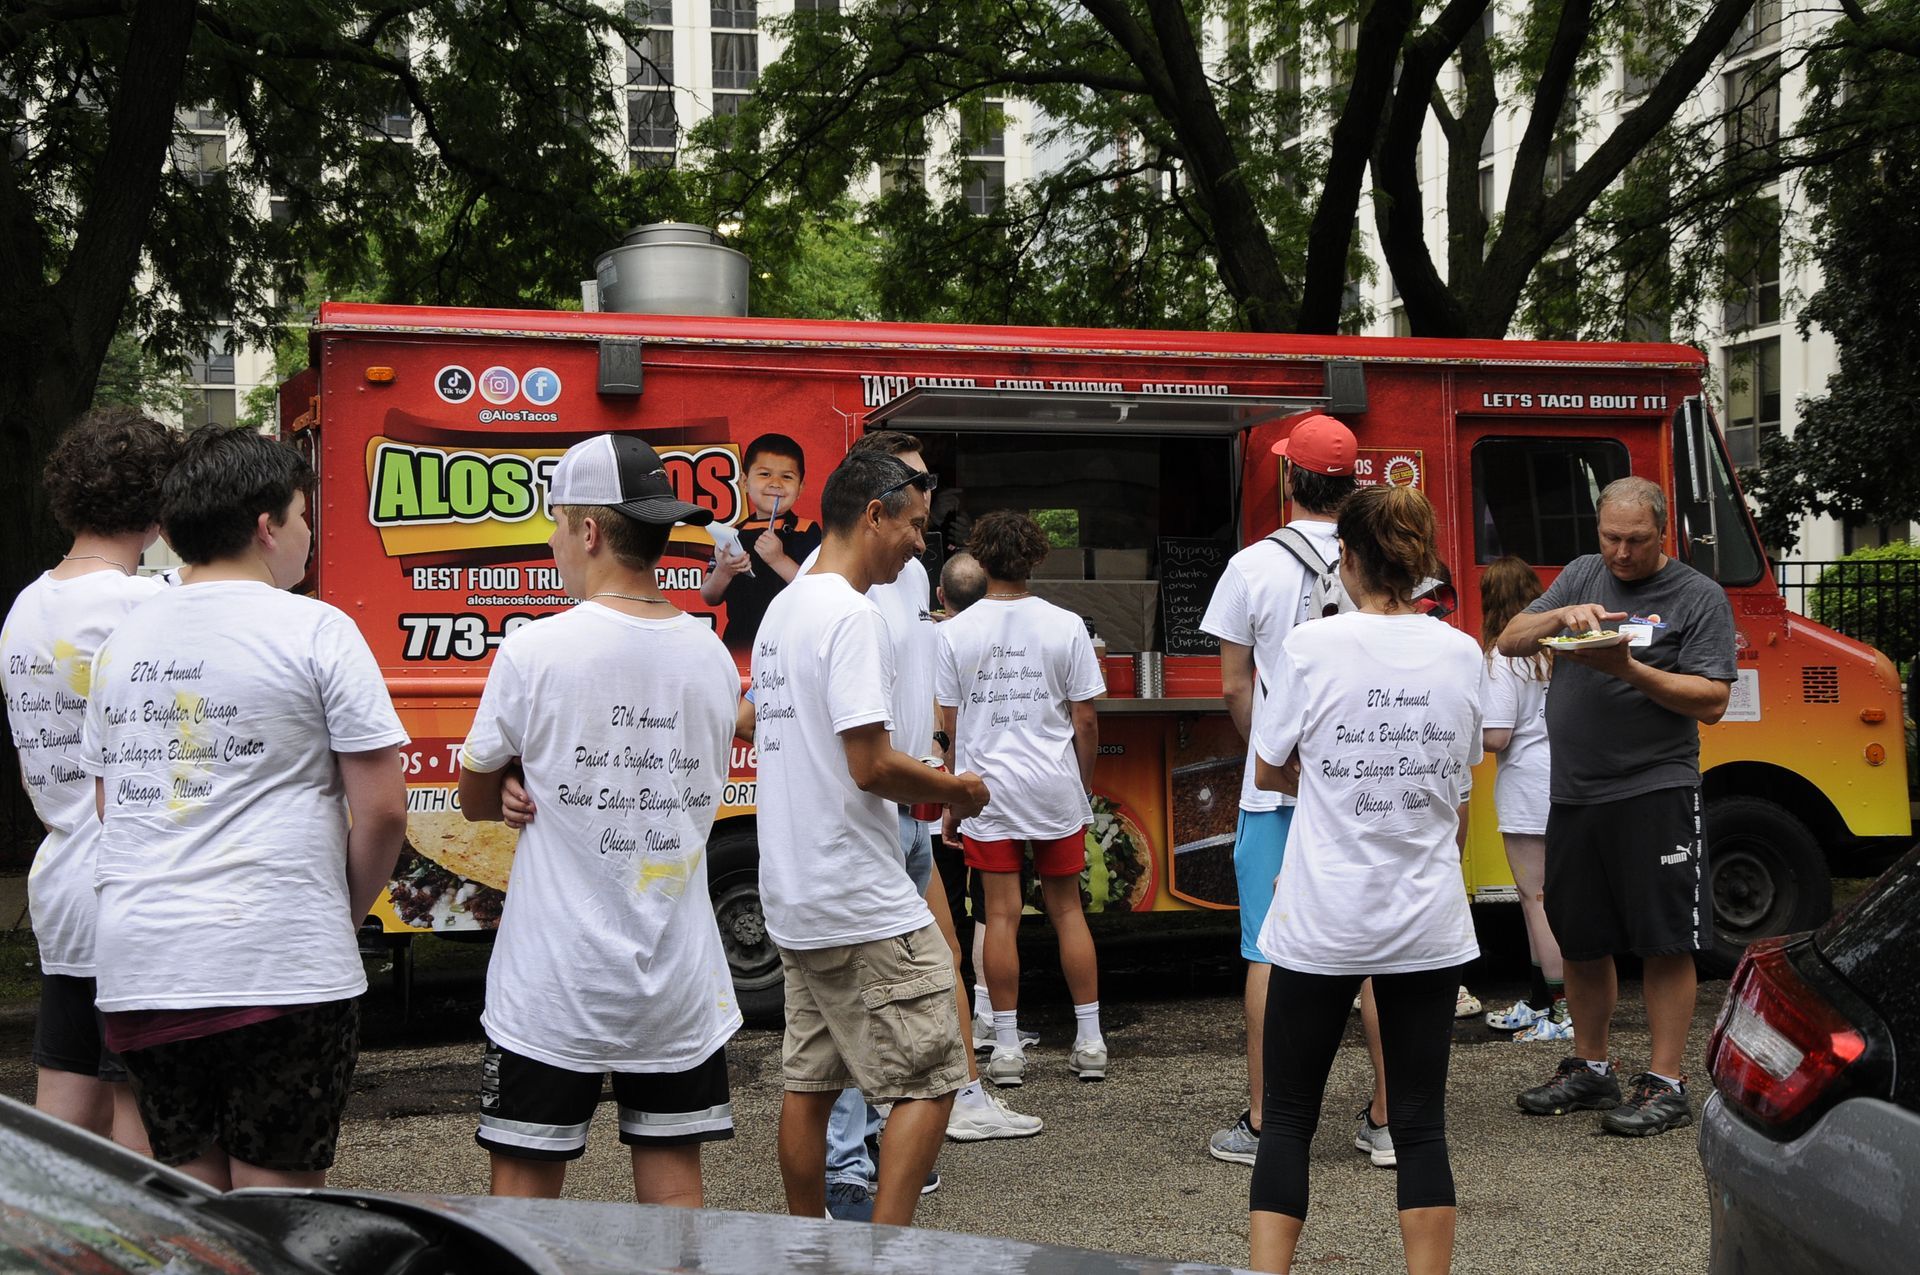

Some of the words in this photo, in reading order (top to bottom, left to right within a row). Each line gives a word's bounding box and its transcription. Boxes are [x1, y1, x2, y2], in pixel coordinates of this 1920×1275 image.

[1483, 393, 1532, 408] LET'S
[1537, 394, 1584, 408] TACO
[1590, 395, 1638, 409] BOUT
[1643, 396, 1667, 410] IT!
[479, 410, 558, 423] @AlosTacos
[375, 448, 534, 521] ALOS
[1161, 541, 1221, 560] Toppings
[413, 567, 462, 590] BEST
[468, 567, 520, 590] FOOD
[525, 567, 564, 590] TRU
[656, 566, 702, 590] CAGO
[131, 660, 159, 682] 27th
[161, 660, 204, 683] Annual
[1367, 687, 1391, 708] 27th
[1393, 688, 1431, 708] Annual
[129, 709, 137, 722] a
[143, 699, 189, 729] Brighter
[194, 697, 239, 727] Chicago
[611, 705, 635, 727] 27th
[636, 706, 678, 730] Annual
[1336, 724, 1366, 746] Paint
[1368, 730, 1376, 743] a
[1379, 722, 1419, 748] Brighter
[168, 738, 219, 766] Bilingual
[223, 735, 266, 763] Center
[574, 745, 610, 769] Paint
[613, 753, 621, 768] a
[624, 745, 664, 776] Brighter
[1321, 759, 1350, 781] Ruben
[1354, 759, 1395, 784] Salazar
[173, 777, 213, 799] Illinois
[558, 783, 593, 807] Ruben
[681, 786, 712, 812] Center
[1660, 852, 1687, 865] PUMA
[483, 1053, 502, 1091] NBA
